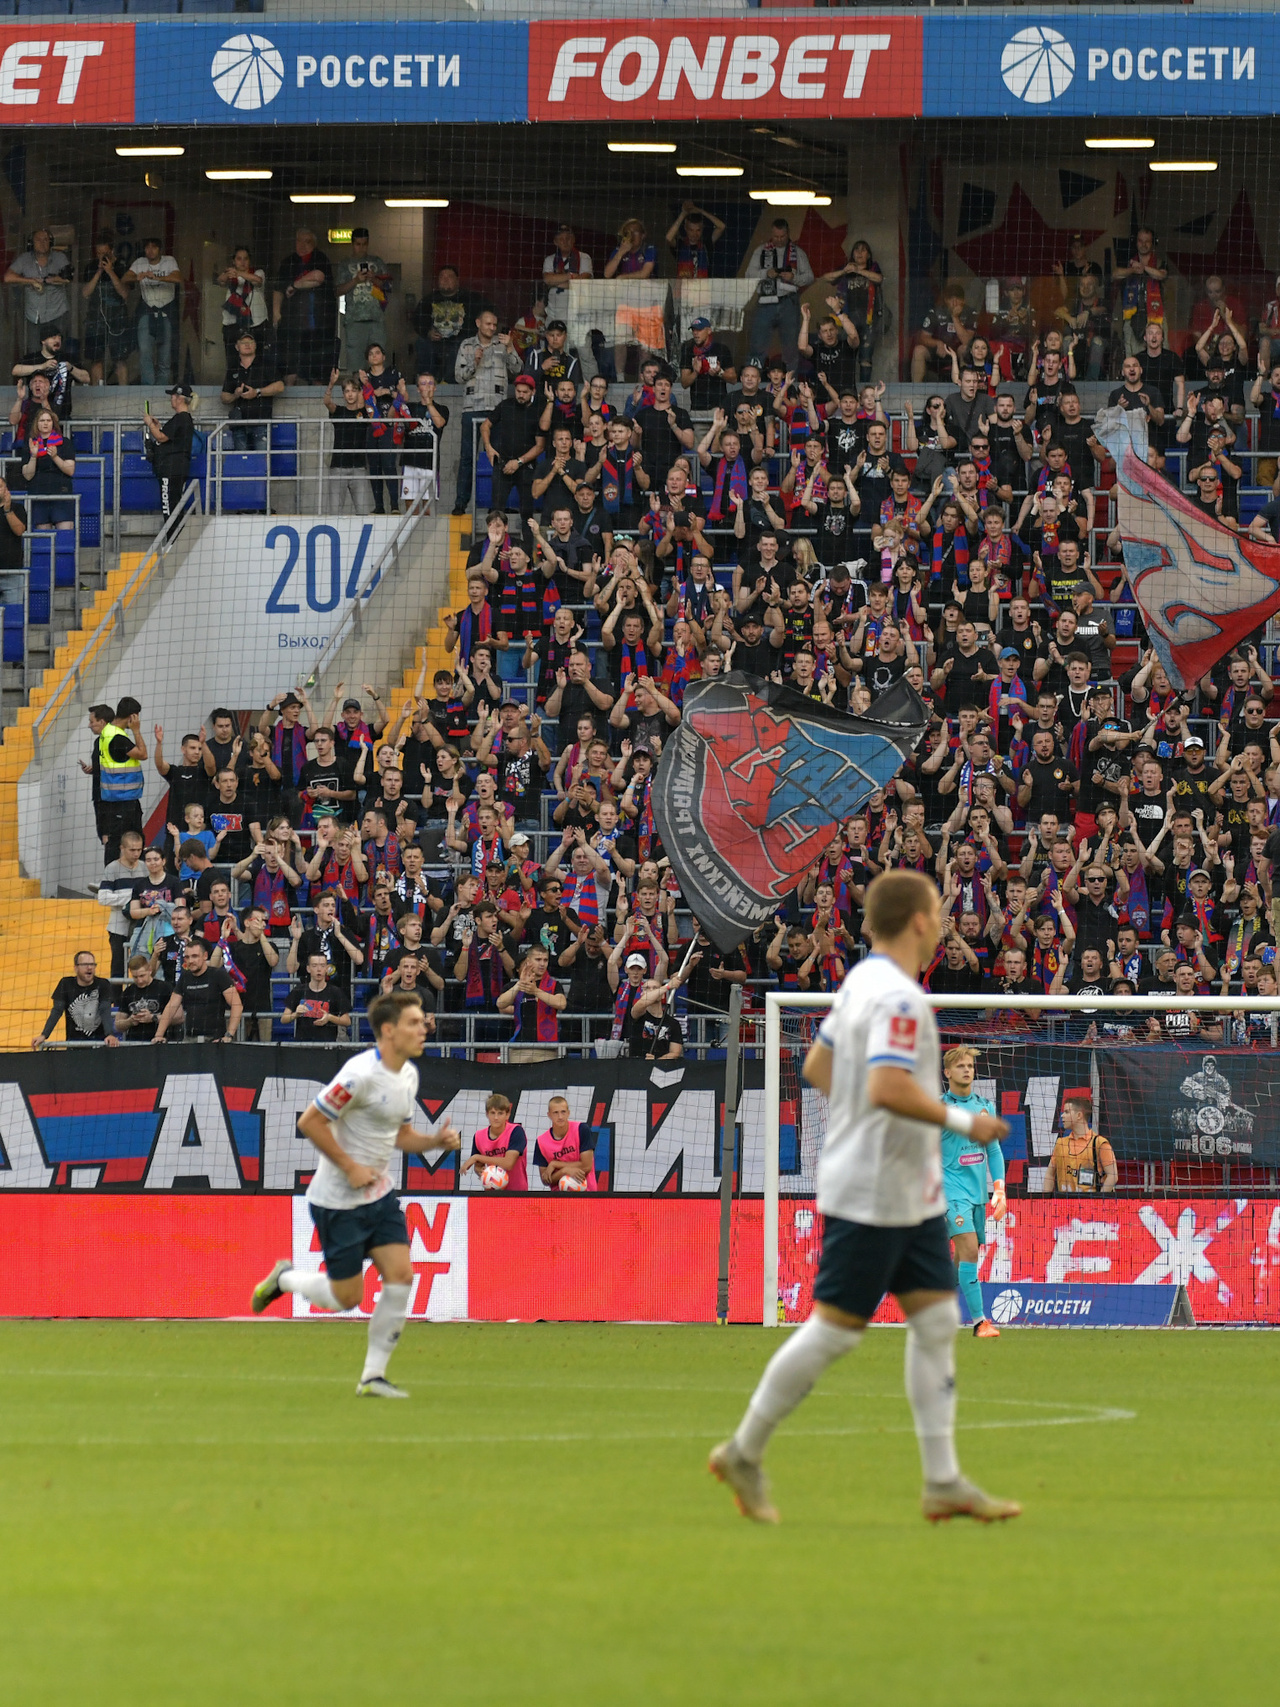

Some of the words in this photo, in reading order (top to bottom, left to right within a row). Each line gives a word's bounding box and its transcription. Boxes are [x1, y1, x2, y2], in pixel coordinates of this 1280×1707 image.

[296, 54, 460, 88] РОССЕТИ
[548, 34, 891, 102] FONBET
[1088, 47, 1256, 81] РОССЕТИ
[162, 477, 171, 517] PROFIT
[1191, 1134, 1232, 1156] 106
[1025, 1299, 1091, 1316] РОССЕТИ
